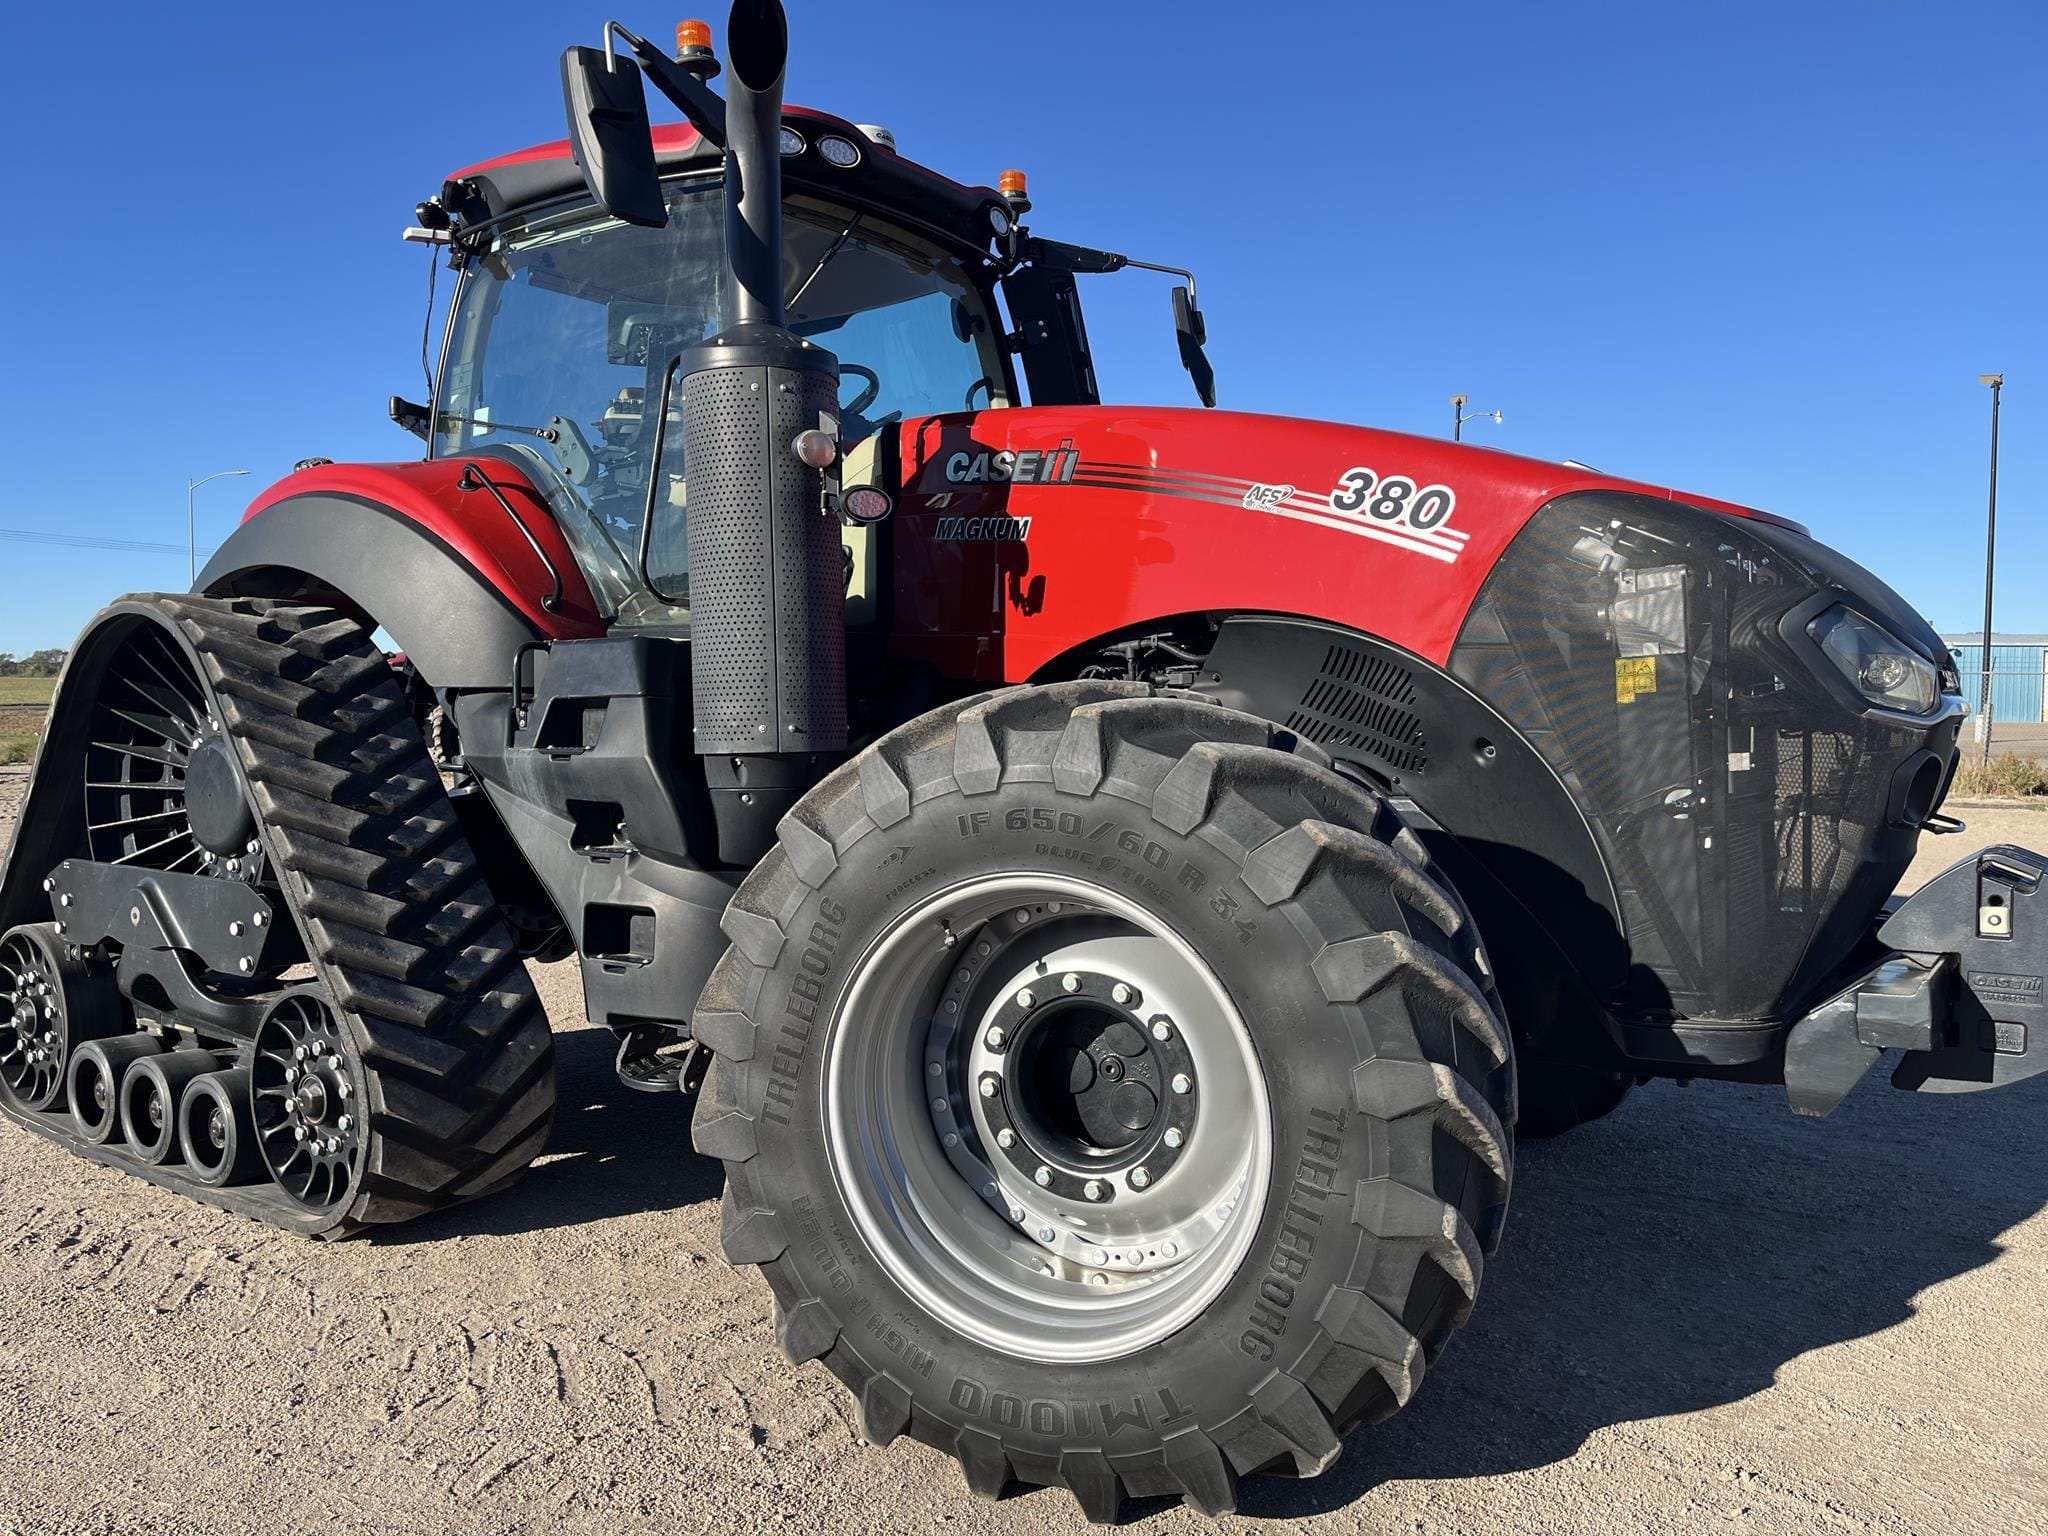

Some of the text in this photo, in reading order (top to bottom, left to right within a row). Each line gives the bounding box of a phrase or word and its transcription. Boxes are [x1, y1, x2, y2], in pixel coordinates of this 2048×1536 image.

[936, 516, 1032, 541] MAGNUM
[1246, 485, 1283, 504] AFS
[1331, 469, 1454, 532] 380
[956, 807, 1262, 945] IF 650/60 R 34
[760, 896, 847, 1126] TRELLEBORG
[1240, 1106, 1350, 1363] TRELLEBORG
[791, 1195, 939, 1381] HIGH POWER
[948, 1375, 1195, 1439] TM1000
